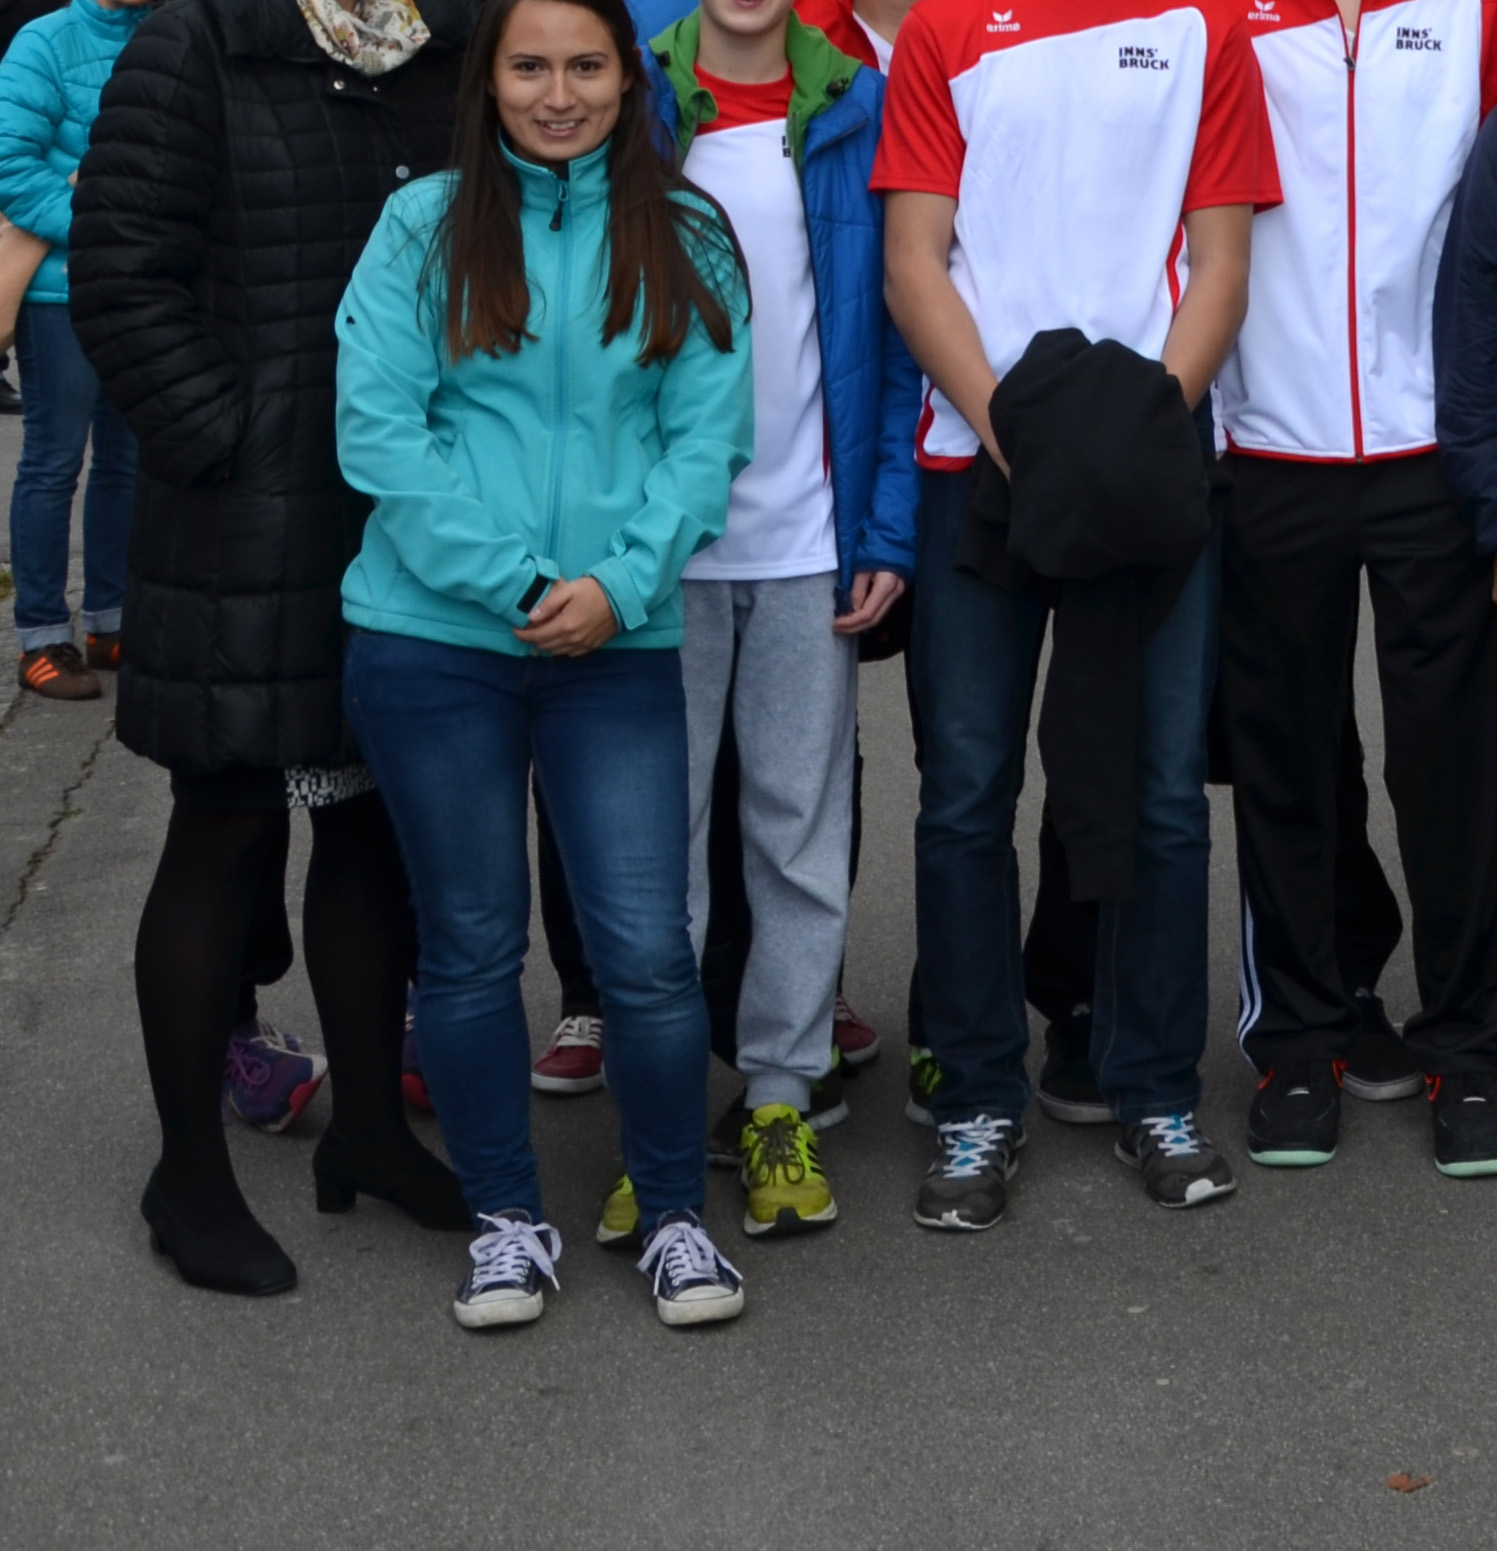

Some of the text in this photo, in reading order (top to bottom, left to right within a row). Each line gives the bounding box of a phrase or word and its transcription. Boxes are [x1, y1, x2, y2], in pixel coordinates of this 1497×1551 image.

[1248, 11, 1281, 23] erima
[986, 22, 1021, 33] erima
[1396, 27, 1433, 39] INNS'
[1395, 39, 1442, 51] BRUCK
[1118, 46, 1158, 58] INNS'
[1118, 57, 1170, 70] BRUCK
